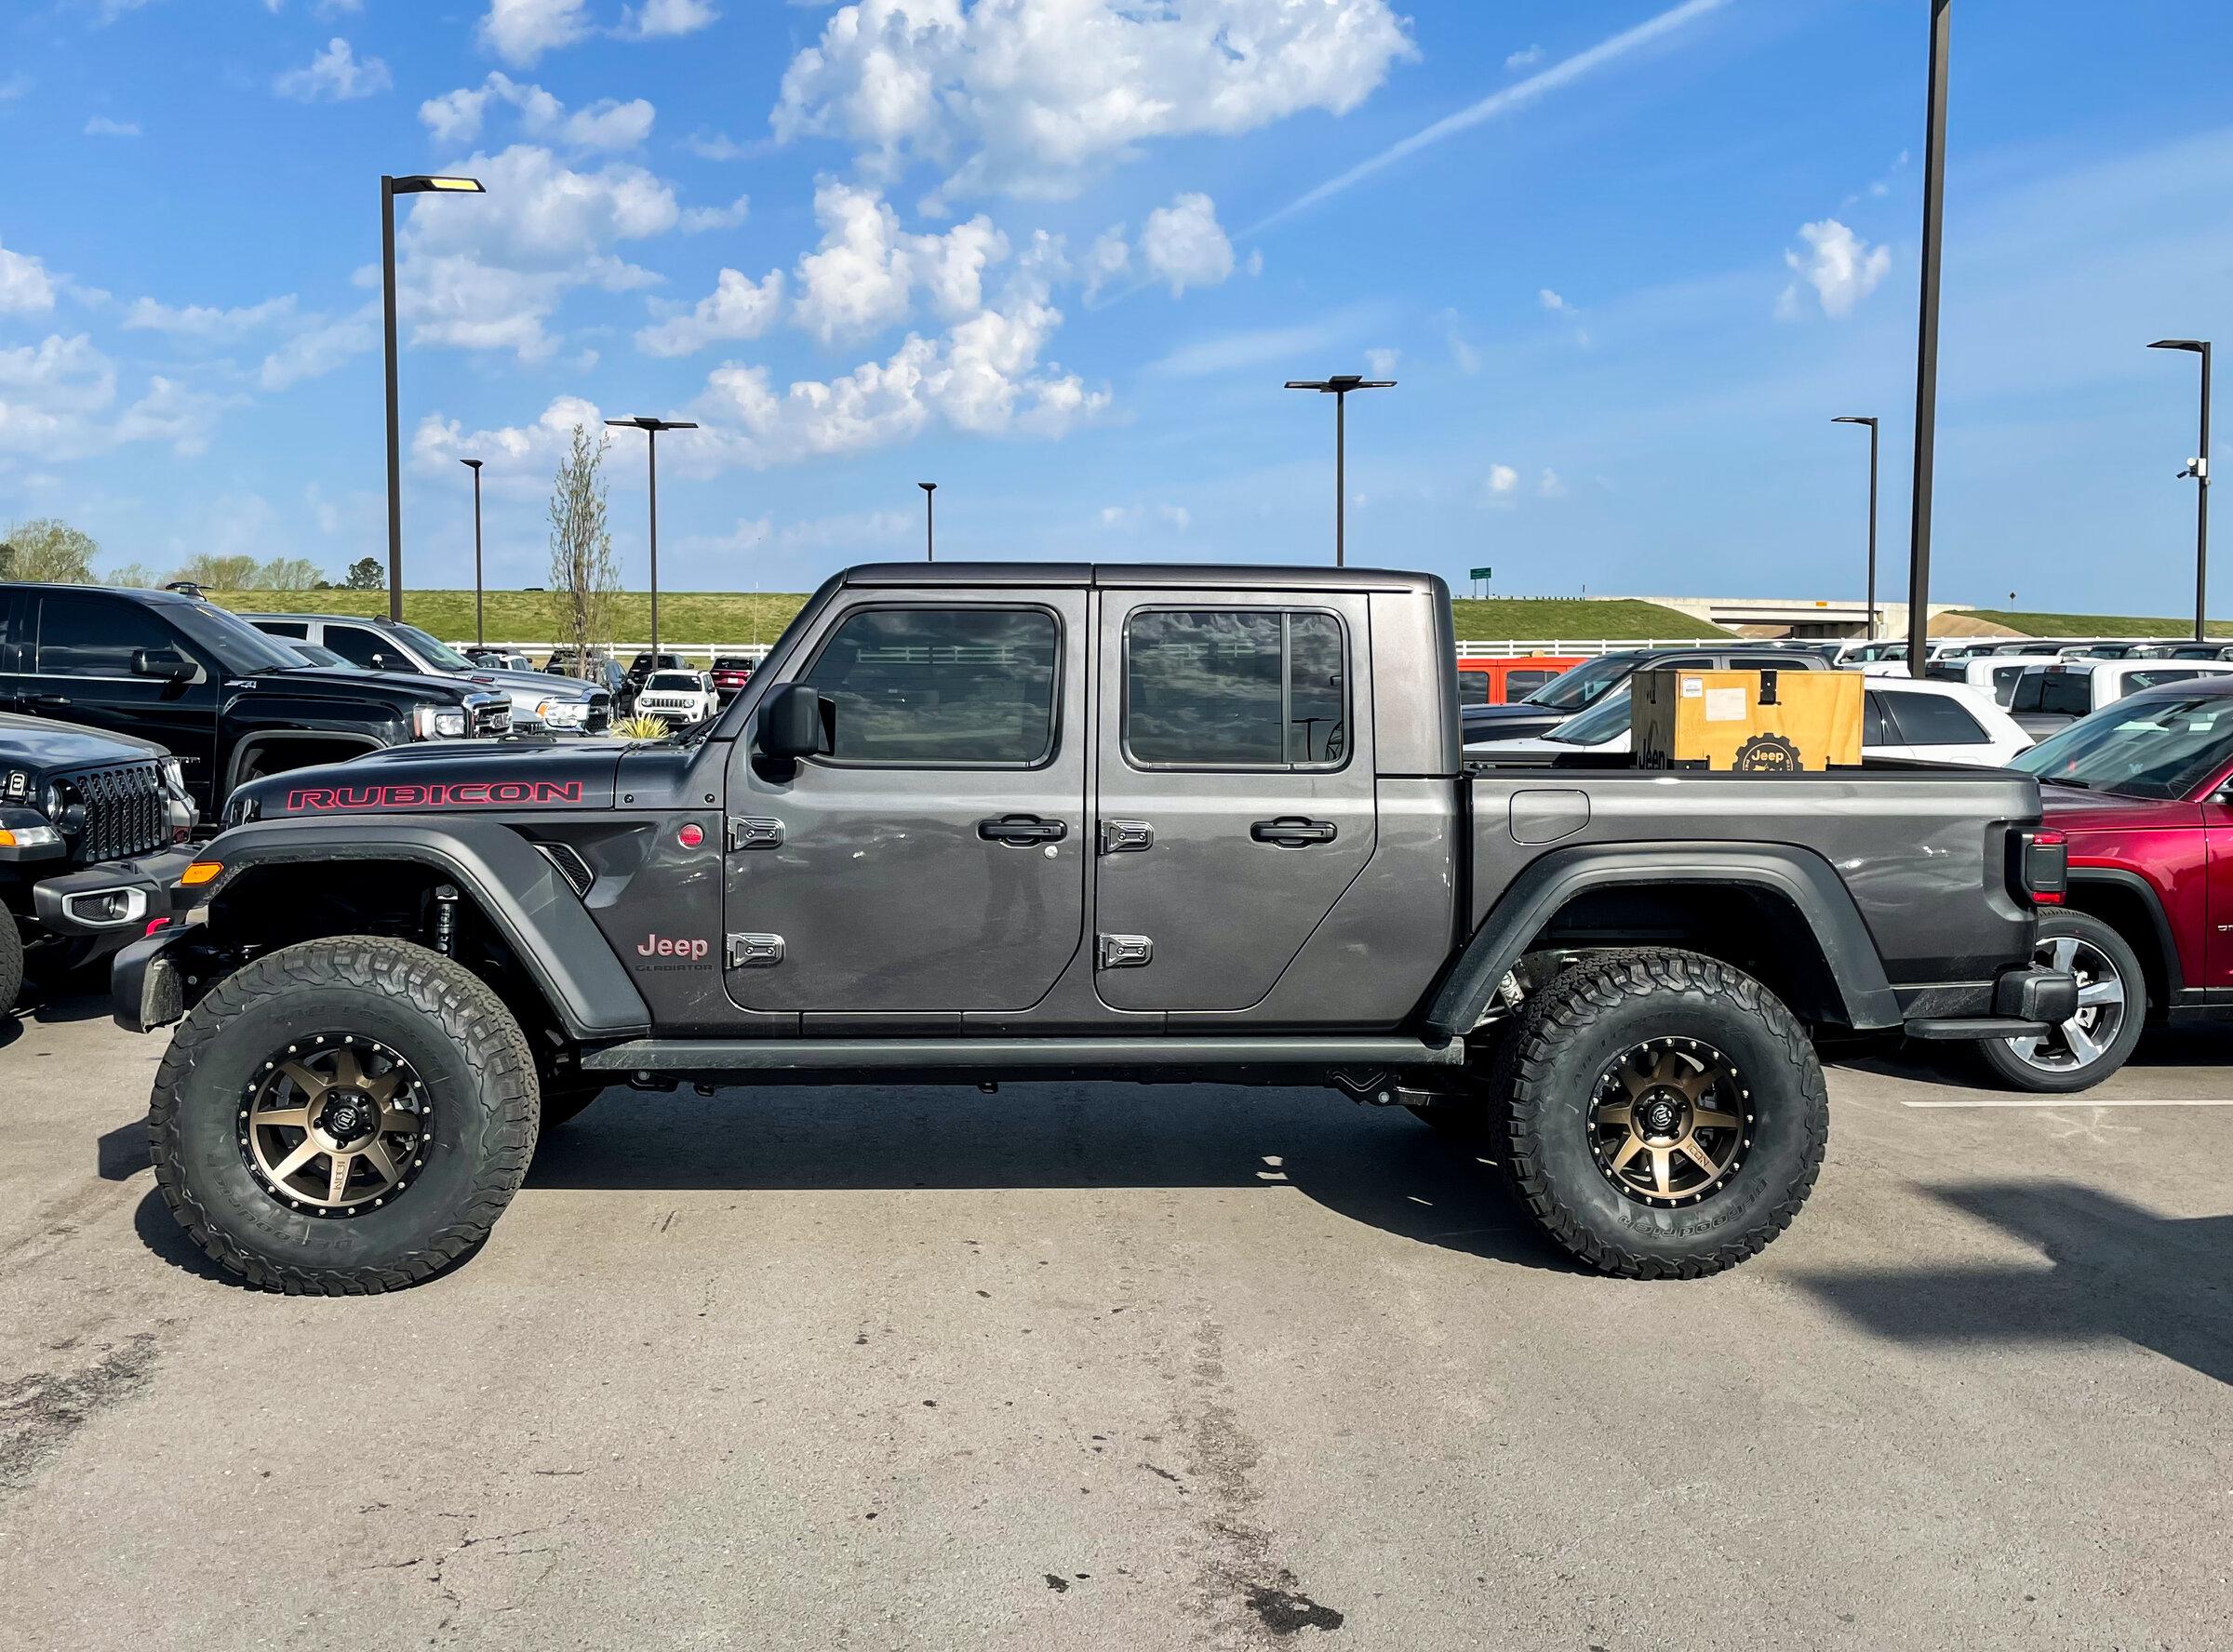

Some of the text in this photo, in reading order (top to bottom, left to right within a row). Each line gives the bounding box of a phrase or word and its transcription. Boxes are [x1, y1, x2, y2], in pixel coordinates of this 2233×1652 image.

[1751, 750, 1785, 763] Jeep
[287, 781, 582, 810] RUBICON
[636, 933, 709, 961] Jeep
[635, 964, 714, 972] GLADIATOR
[1686, 1143, 1710, 1167] ICON
[333, 1161, 346, 1191] ICON
